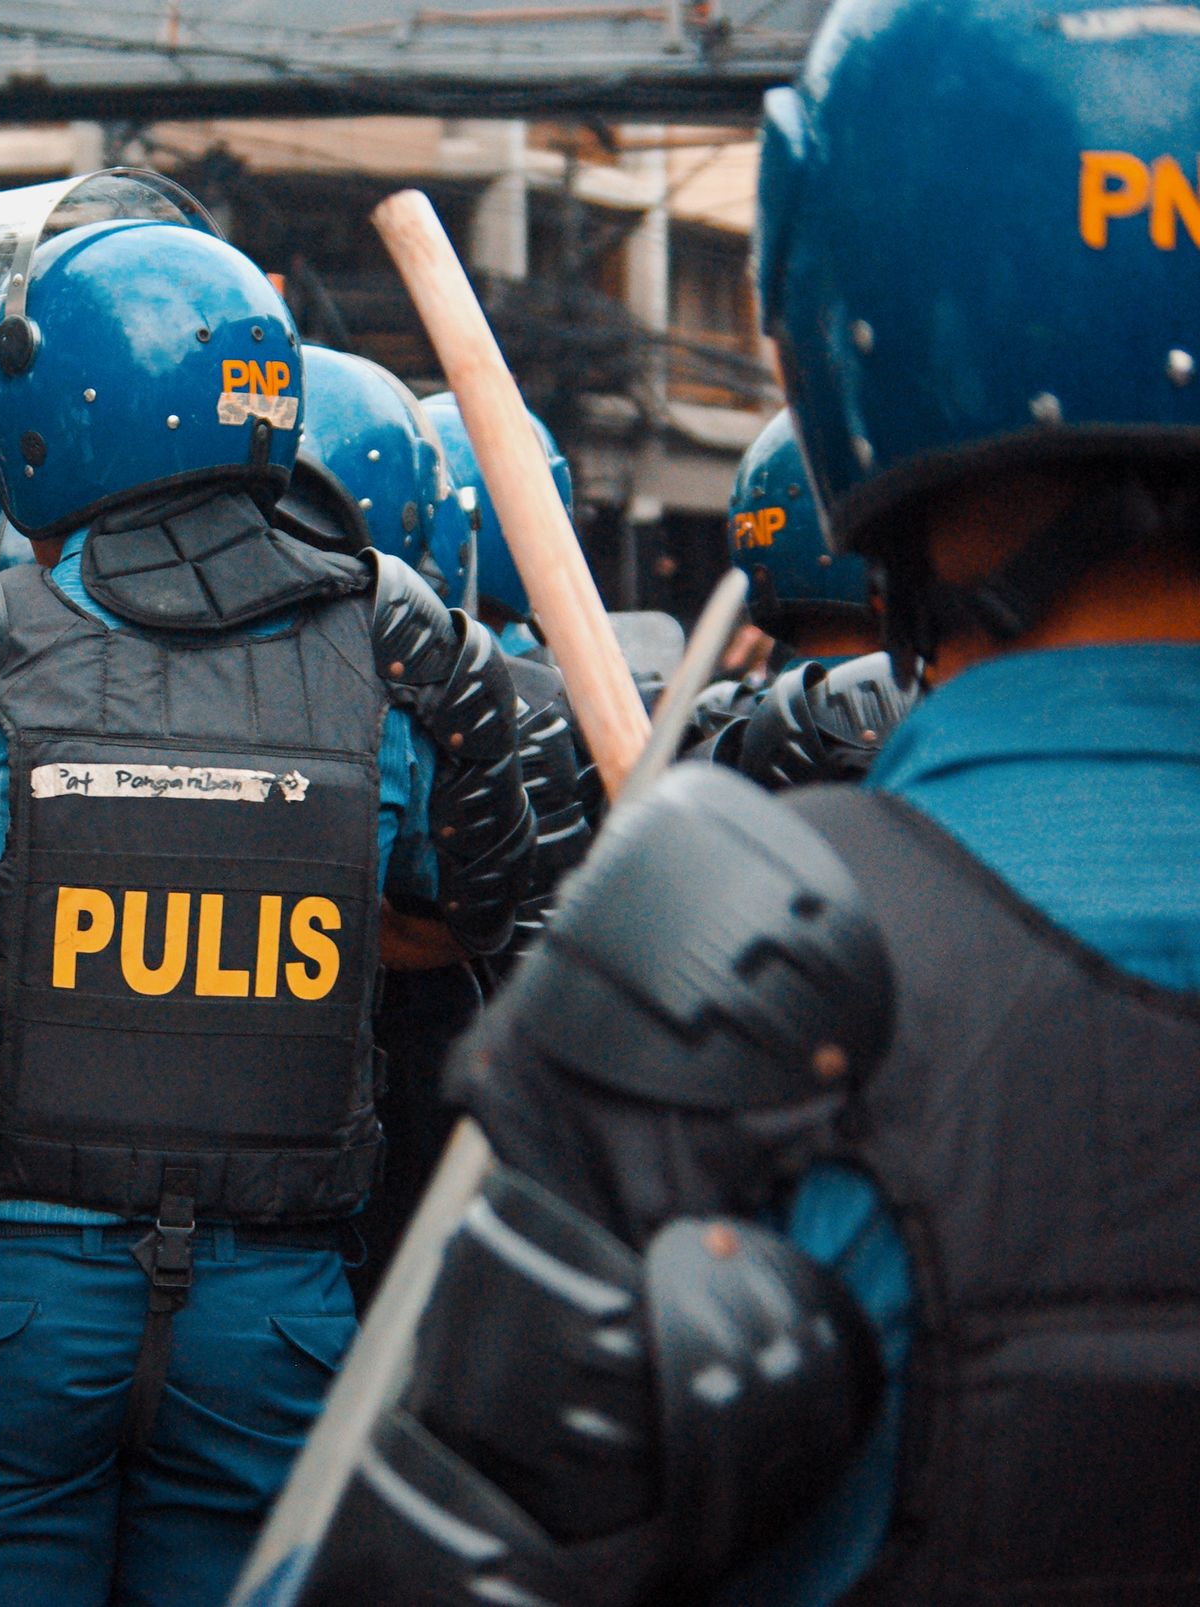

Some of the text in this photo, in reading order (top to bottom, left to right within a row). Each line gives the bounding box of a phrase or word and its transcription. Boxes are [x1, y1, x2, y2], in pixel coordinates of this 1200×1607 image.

[1079, 150, 1200, 251] PN
[222, 359, 291, 402] PNP
[734, 507, 786, 550] PNP
[52, 886, 342, 1001] PULIS
